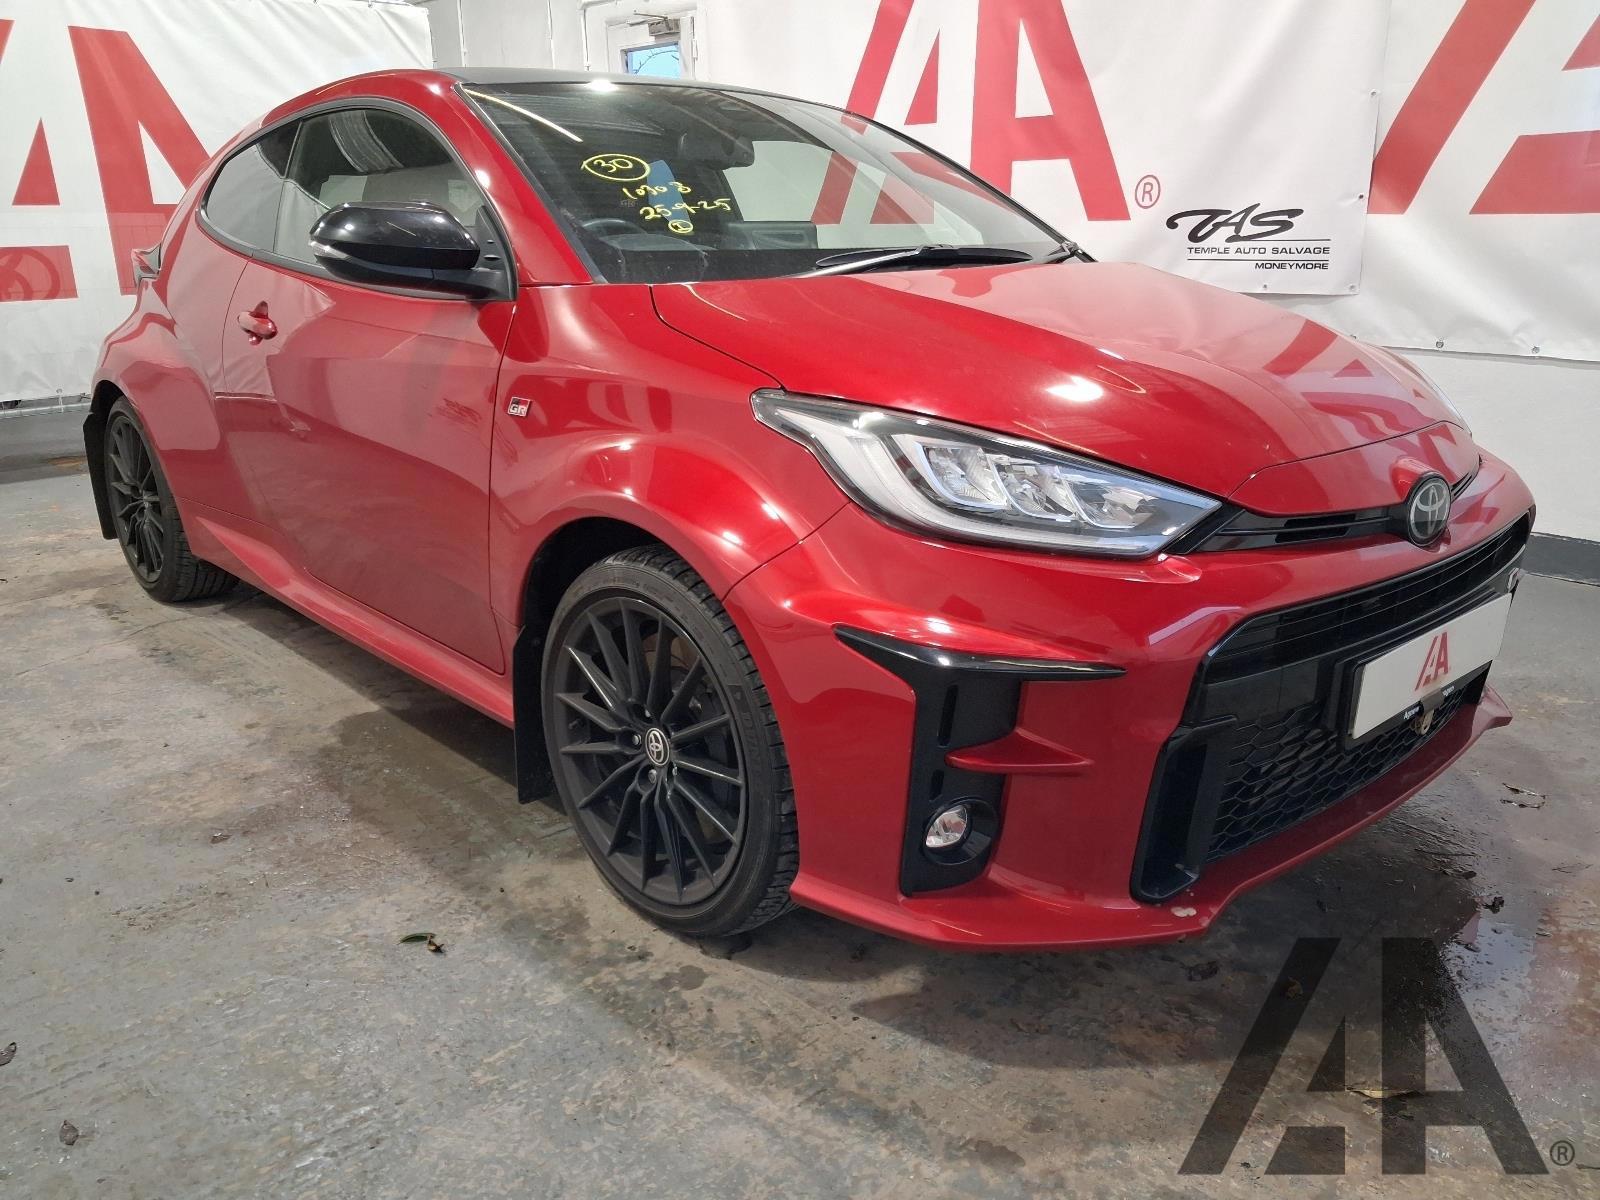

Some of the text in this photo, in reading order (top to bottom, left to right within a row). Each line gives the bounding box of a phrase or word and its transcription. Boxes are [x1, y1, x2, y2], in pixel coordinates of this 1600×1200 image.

[1166, 202, 1305, 243] TAS
[1187, 246, 1330, 255] TEMPLE AUTO SALVAGE
[1254, 262, 1329, 270] MONEYMORE
